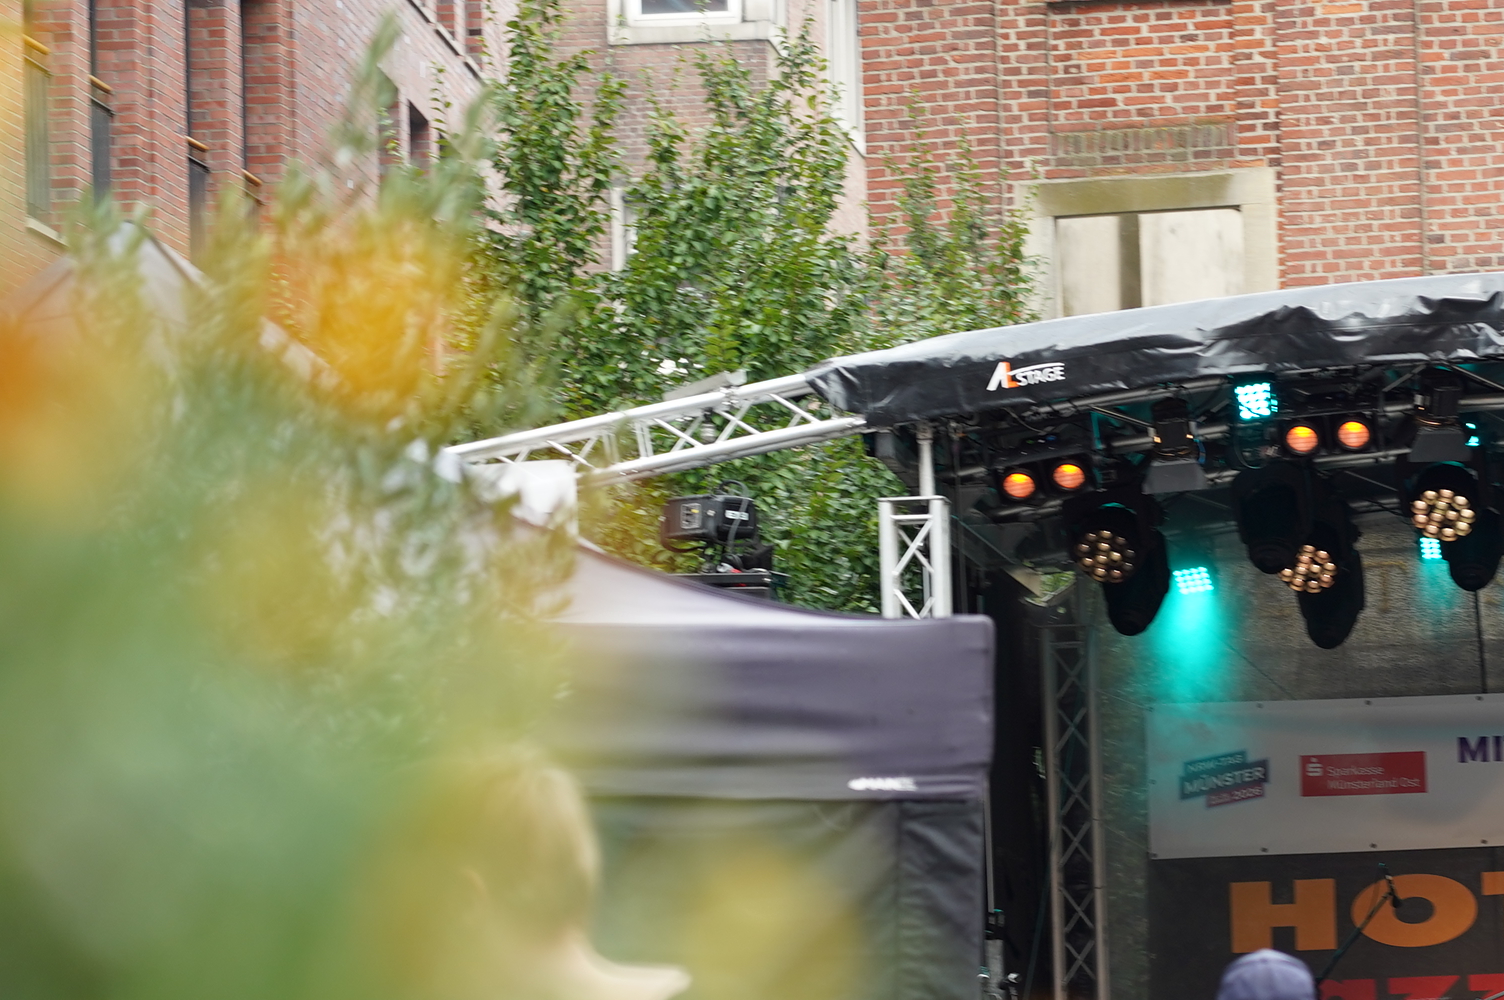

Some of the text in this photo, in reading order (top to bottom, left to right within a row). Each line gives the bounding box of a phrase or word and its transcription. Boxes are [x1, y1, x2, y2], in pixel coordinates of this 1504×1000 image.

[1326, 765, 1385, 778] Sparkasse
[1183, 767, 1265, 794] MÜNSTER
[1400, 777, 1421, 788] Ost
